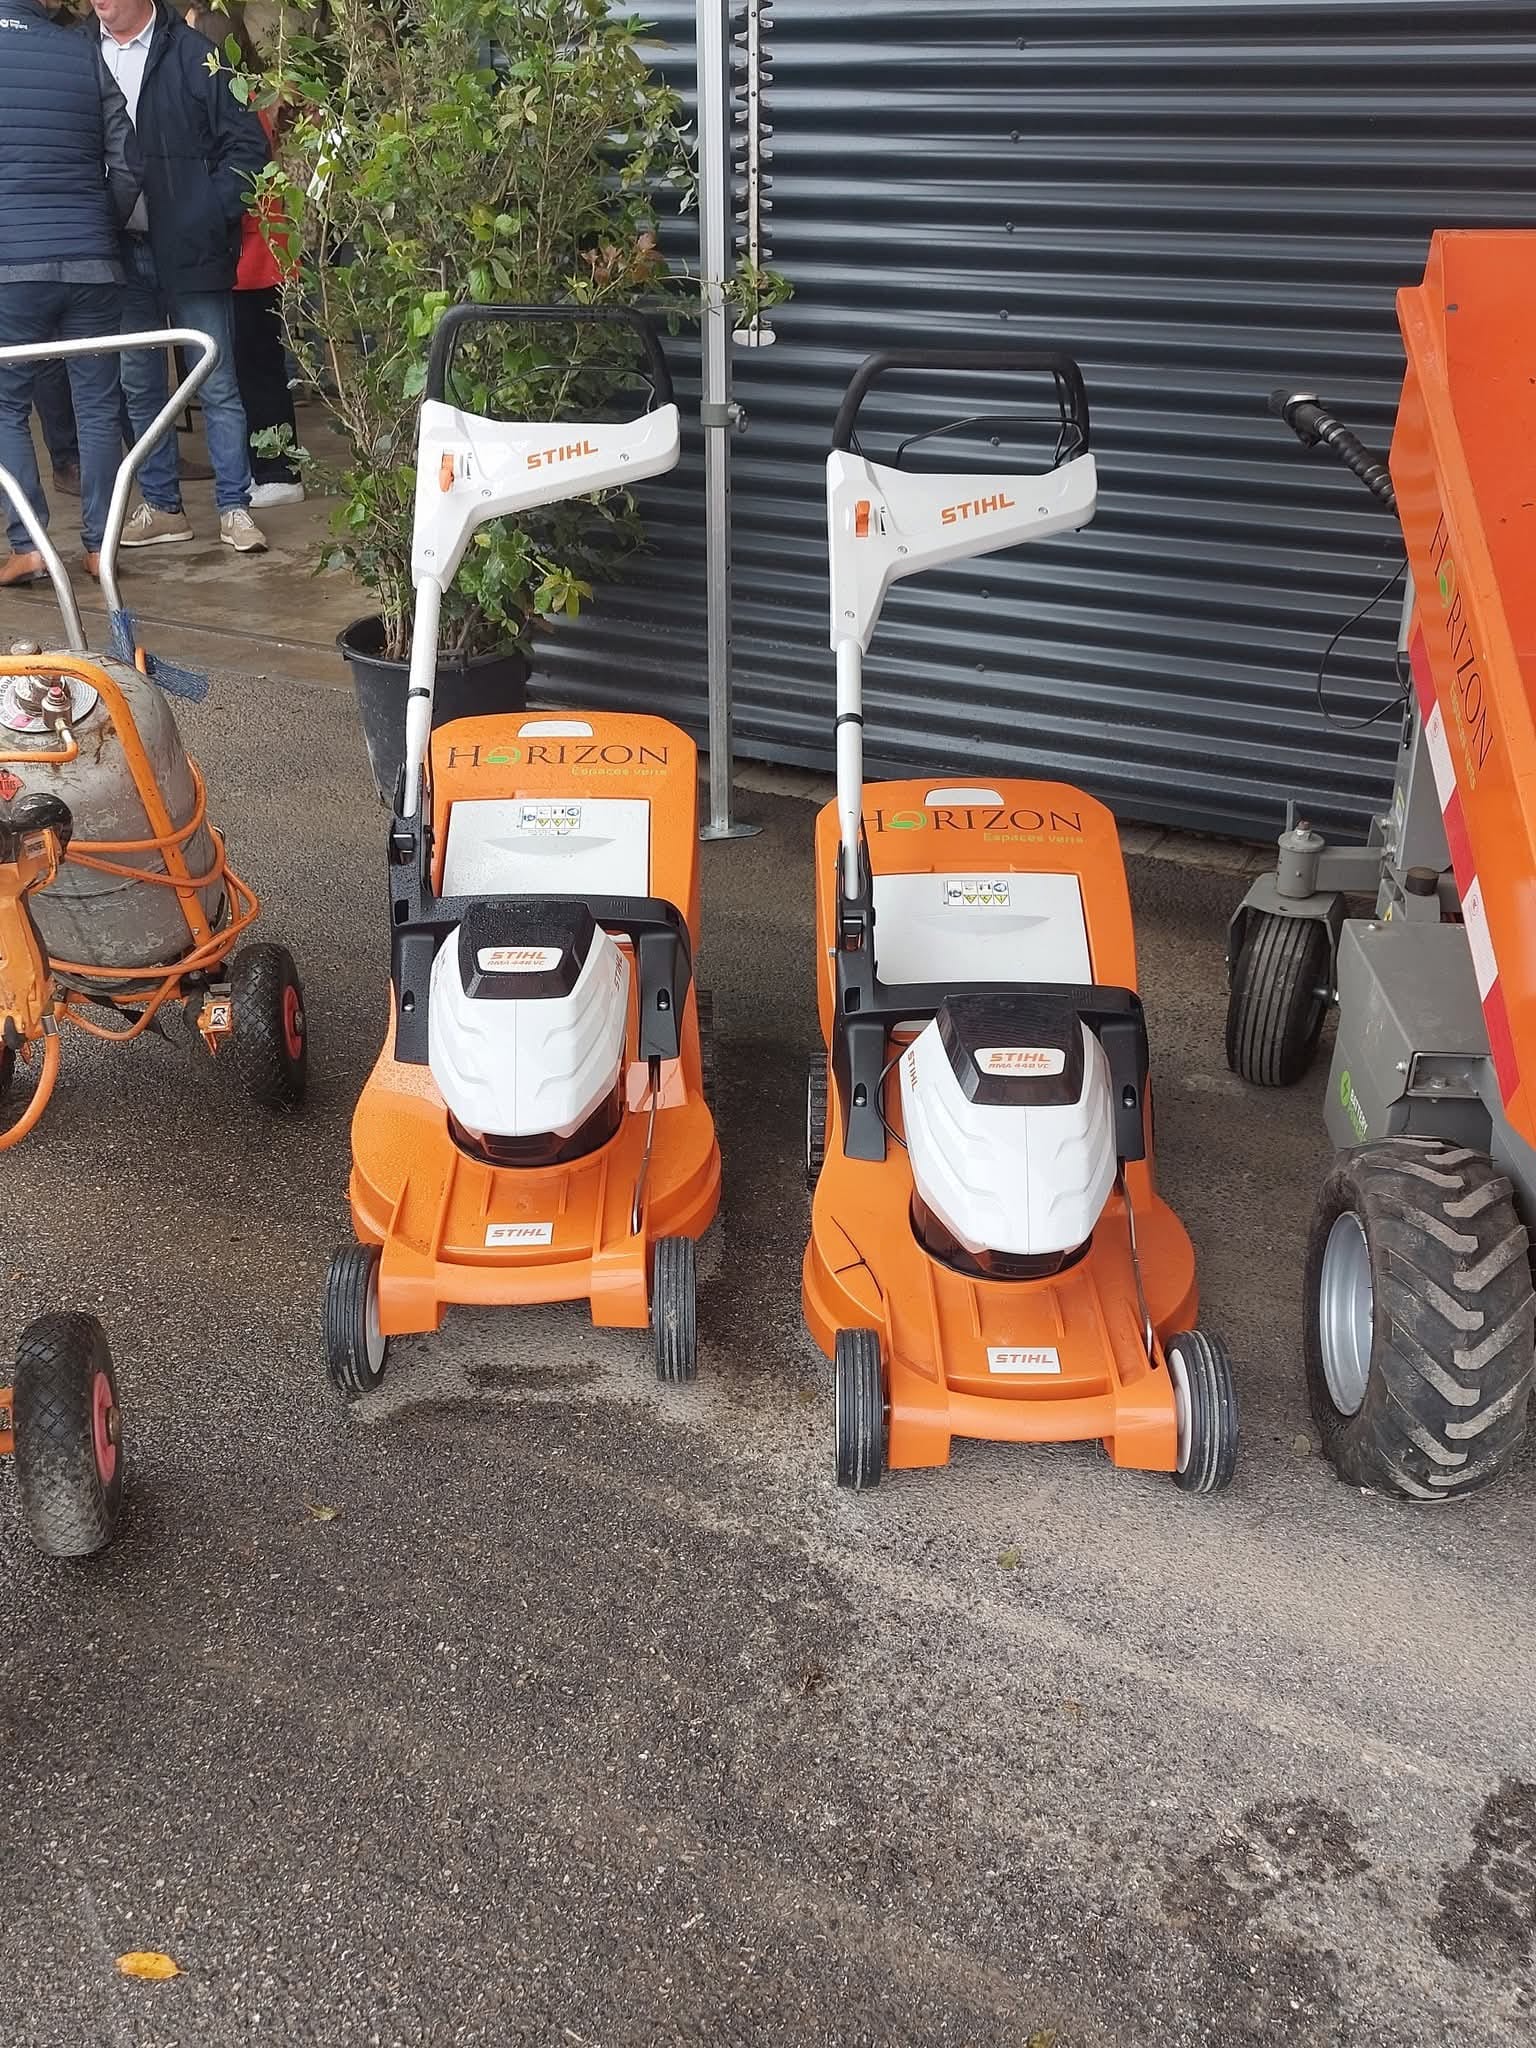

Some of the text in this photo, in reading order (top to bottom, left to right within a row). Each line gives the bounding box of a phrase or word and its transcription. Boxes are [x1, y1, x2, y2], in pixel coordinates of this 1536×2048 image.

[527, 440, 599, 470] STIHL
[941, 493, 1015, 525] STIHL
[447, 744, 669, 769] HORIZON
[490, 951, 548, 960] STIHL
[989, 1053, 1051, 1062] STIHL
[907, 1050, 919, 1093] STIHL
[491, 1228, 548, 1238] STIHL
[995, 1354, 1054, 1364] STIHL
